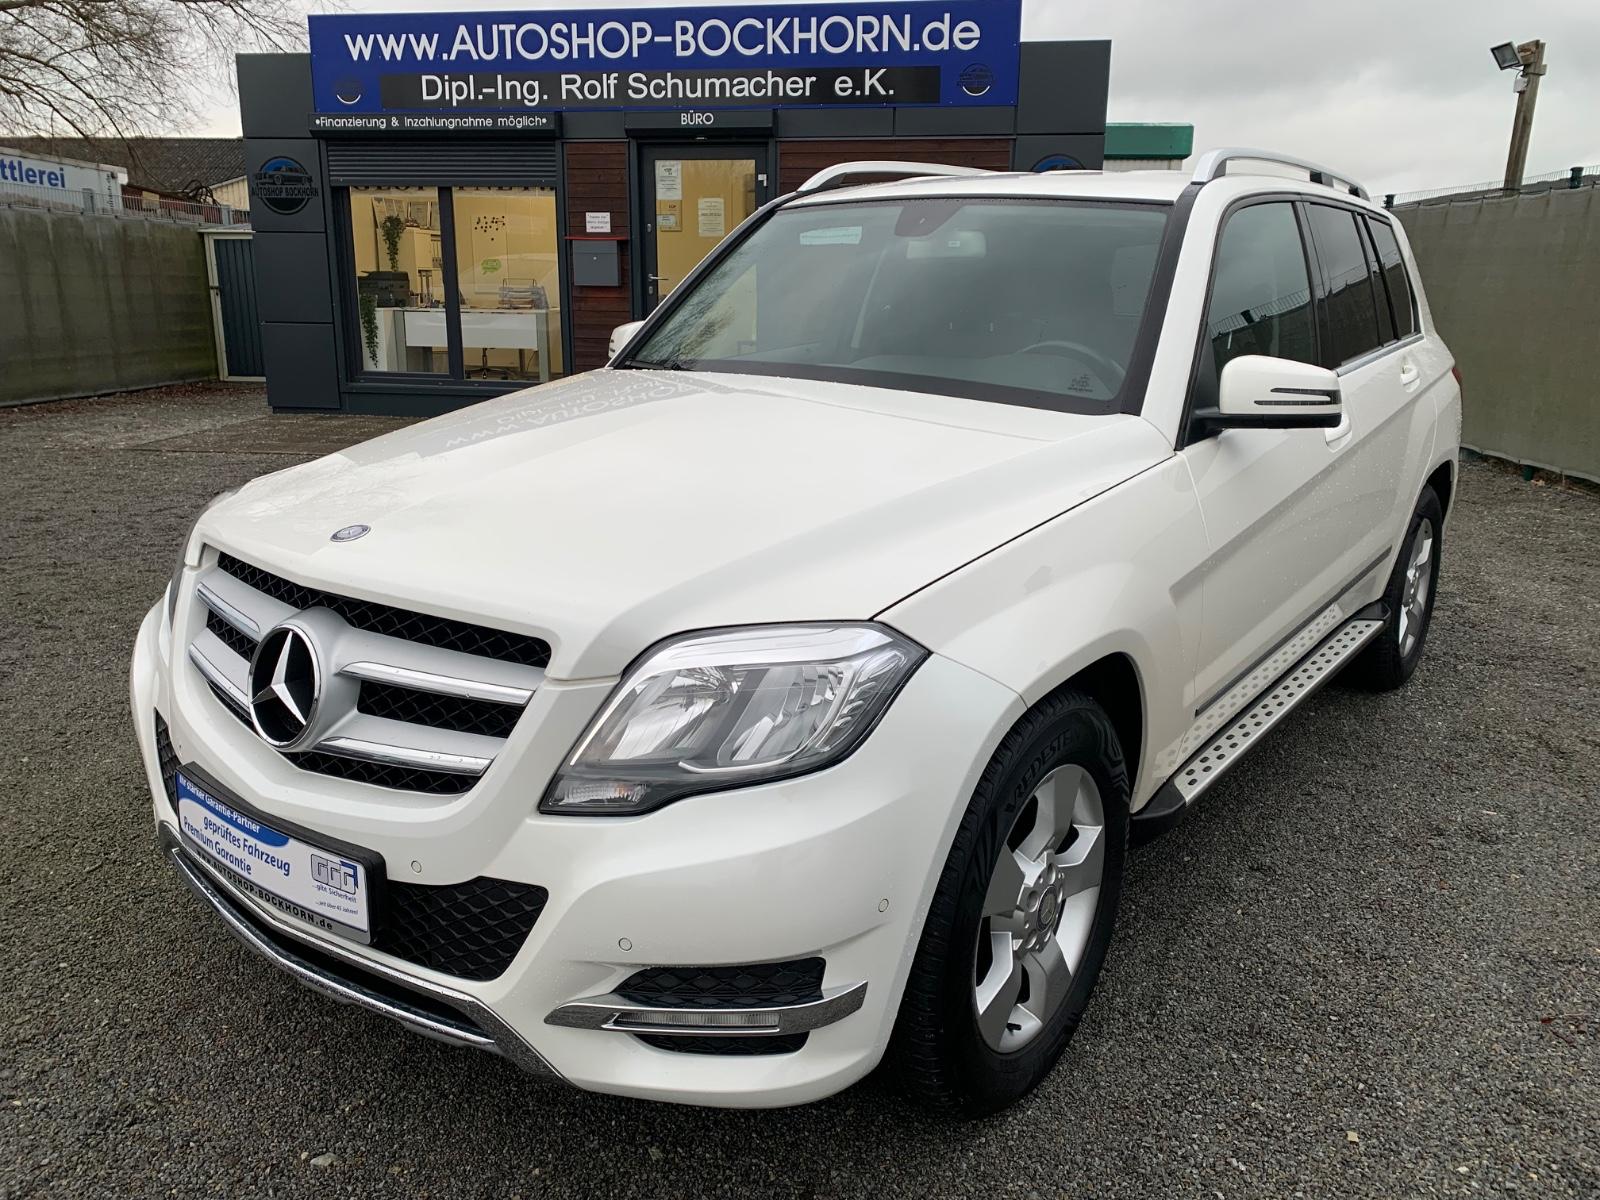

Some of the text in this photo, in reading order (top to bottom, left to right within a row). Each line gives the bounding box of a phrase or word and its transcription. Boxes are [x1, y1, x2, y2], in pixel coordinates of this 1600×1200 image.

[344, 13, 981, 61] www.AUTOSHOP-BOCKHORN.de
[421, 68, 895, 107] Dipl.-Ing. Rolf Schumacher e.K.
[391, 116, 400, 127] &
[404, 116, 493, 129] Inzahlungnahme
[680, 110, 714, 125] BÜRO
[183, 815, 252, 875] Premium Garantie
[203, 816, 292, 877] geprüftes Fahrzeug
